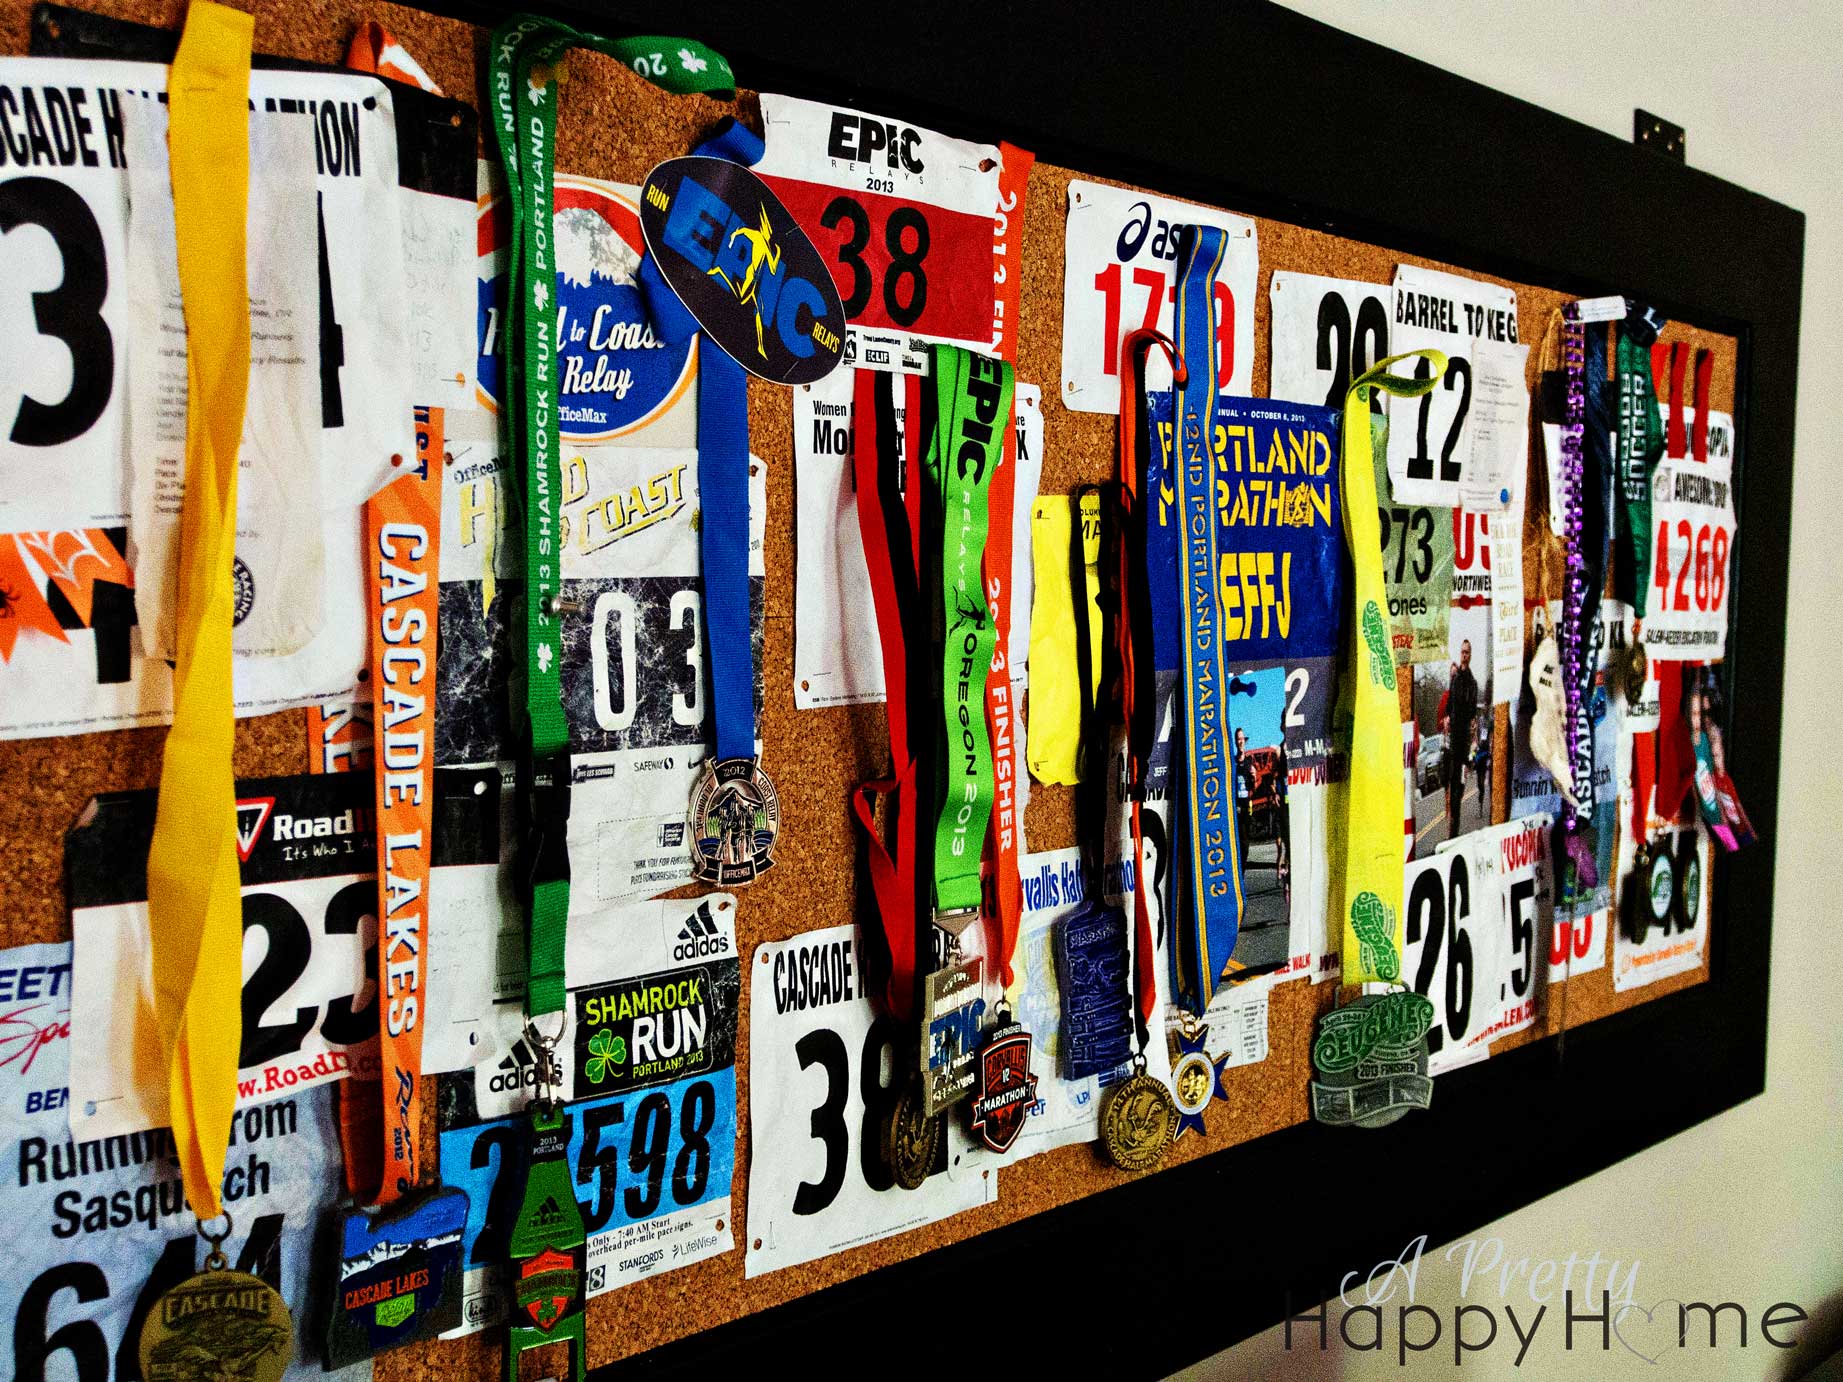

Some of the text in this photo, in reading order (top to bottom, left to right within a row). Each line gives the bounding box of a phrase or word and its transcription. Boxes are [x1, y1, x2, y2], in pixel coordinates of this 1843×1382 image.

[828, 112, 924, 174] EPIC
[530, 116, 548, 271] PORTLAND
[646, 183, 670, 212] RUN
[866, 177, 895, 194] 2013
[819, 195, 932, 328] 38
[812, 321, 841, 354] RELAYS
[1396, 289, 1519, 344] BARREL TO KEG
[535, 320, 550, 383] RUN
[562, 354, 634, 400] Relay
[557, 405, 607, 424] fficeMax
[813, 400, 847, 416] Women
[956, 352, 1002, 486] EPIC
[1251, 410, 1282, 421] OCTOBER
[1406, 355, 1473, 482] 12
[535, 389, 551, 556] SHAMROCK
[1655, 519, 1728, 612] 4268
[1388, 597, 1428, 617] ones
[377, 521, 430, 808] CASCADE
[956, 633, 978, 776] OREGON
[1196, 657, 1222, 822] MARATHON
[633, 760, 664, 772] SAFEWAY
[723, 765, 747, 777] 2012
[990, 687, 1014, 852] FINISHER
[1153, 766, 1168, 777] JEFF
[951, 783, 978, 856] 2013
[311, 842, 339, 858] Who
[384, 829, 423, 1039] LAKES
[673, 934, 729, 961] adidas
[774, 940, 853, 1015] CASCADE
[585, 977, 704, 1026] SHAMROCK
[630, 1004, 707, 1066] RUN
[632, 1057, 684, 1080] PORTLAND
[984, 1086, 1027, 1113] MARATHON
[587, 1242, 622, 1258] overhead
[624, 1234, 656, 1250] per-mile
[592, 1234, 611, 1251] Only
[636, 1222, 650, 1235] AM
[650, 1216, 671, 1232] Start
[680, 1235, 718, 1256] LifeWise
[619, 1249, 664, 1272] STANFORD'S
[344, 1268, 430, 1310] CASCADE LAKES
